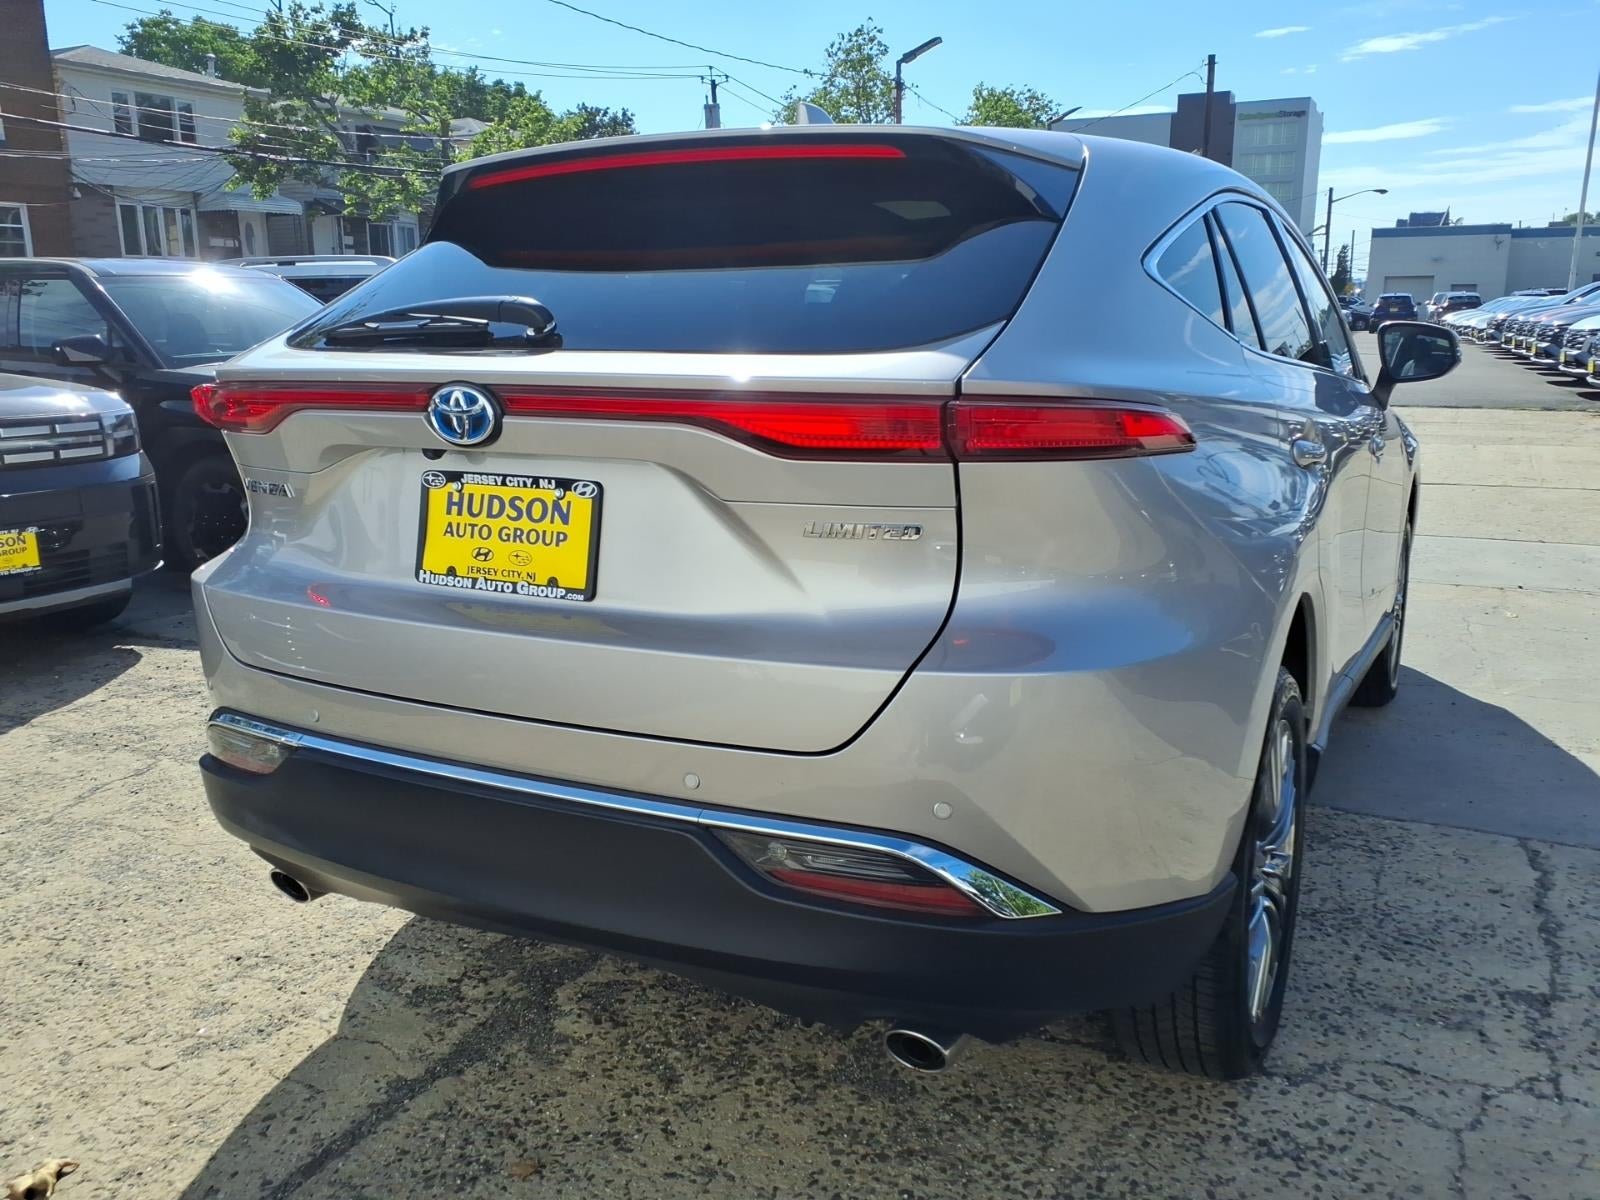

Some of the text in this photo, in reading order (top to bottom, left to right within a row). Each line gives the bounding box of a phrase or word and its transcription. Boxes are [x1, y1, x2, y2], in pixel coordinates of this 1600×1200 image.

[461, 474, 556, 489] JERSEY CITY, NJ
[445, 491, 572, 525] HUDSON
[443, 521, 568, 547] AUTO GROUP
[803, 520, 923, 540] LIMITED
[419, 570, 474, 587] HUDSON
[475, 577, 513, 593] AUTO
[467, 565, 536, 583] JERSEY CITY, NJ
